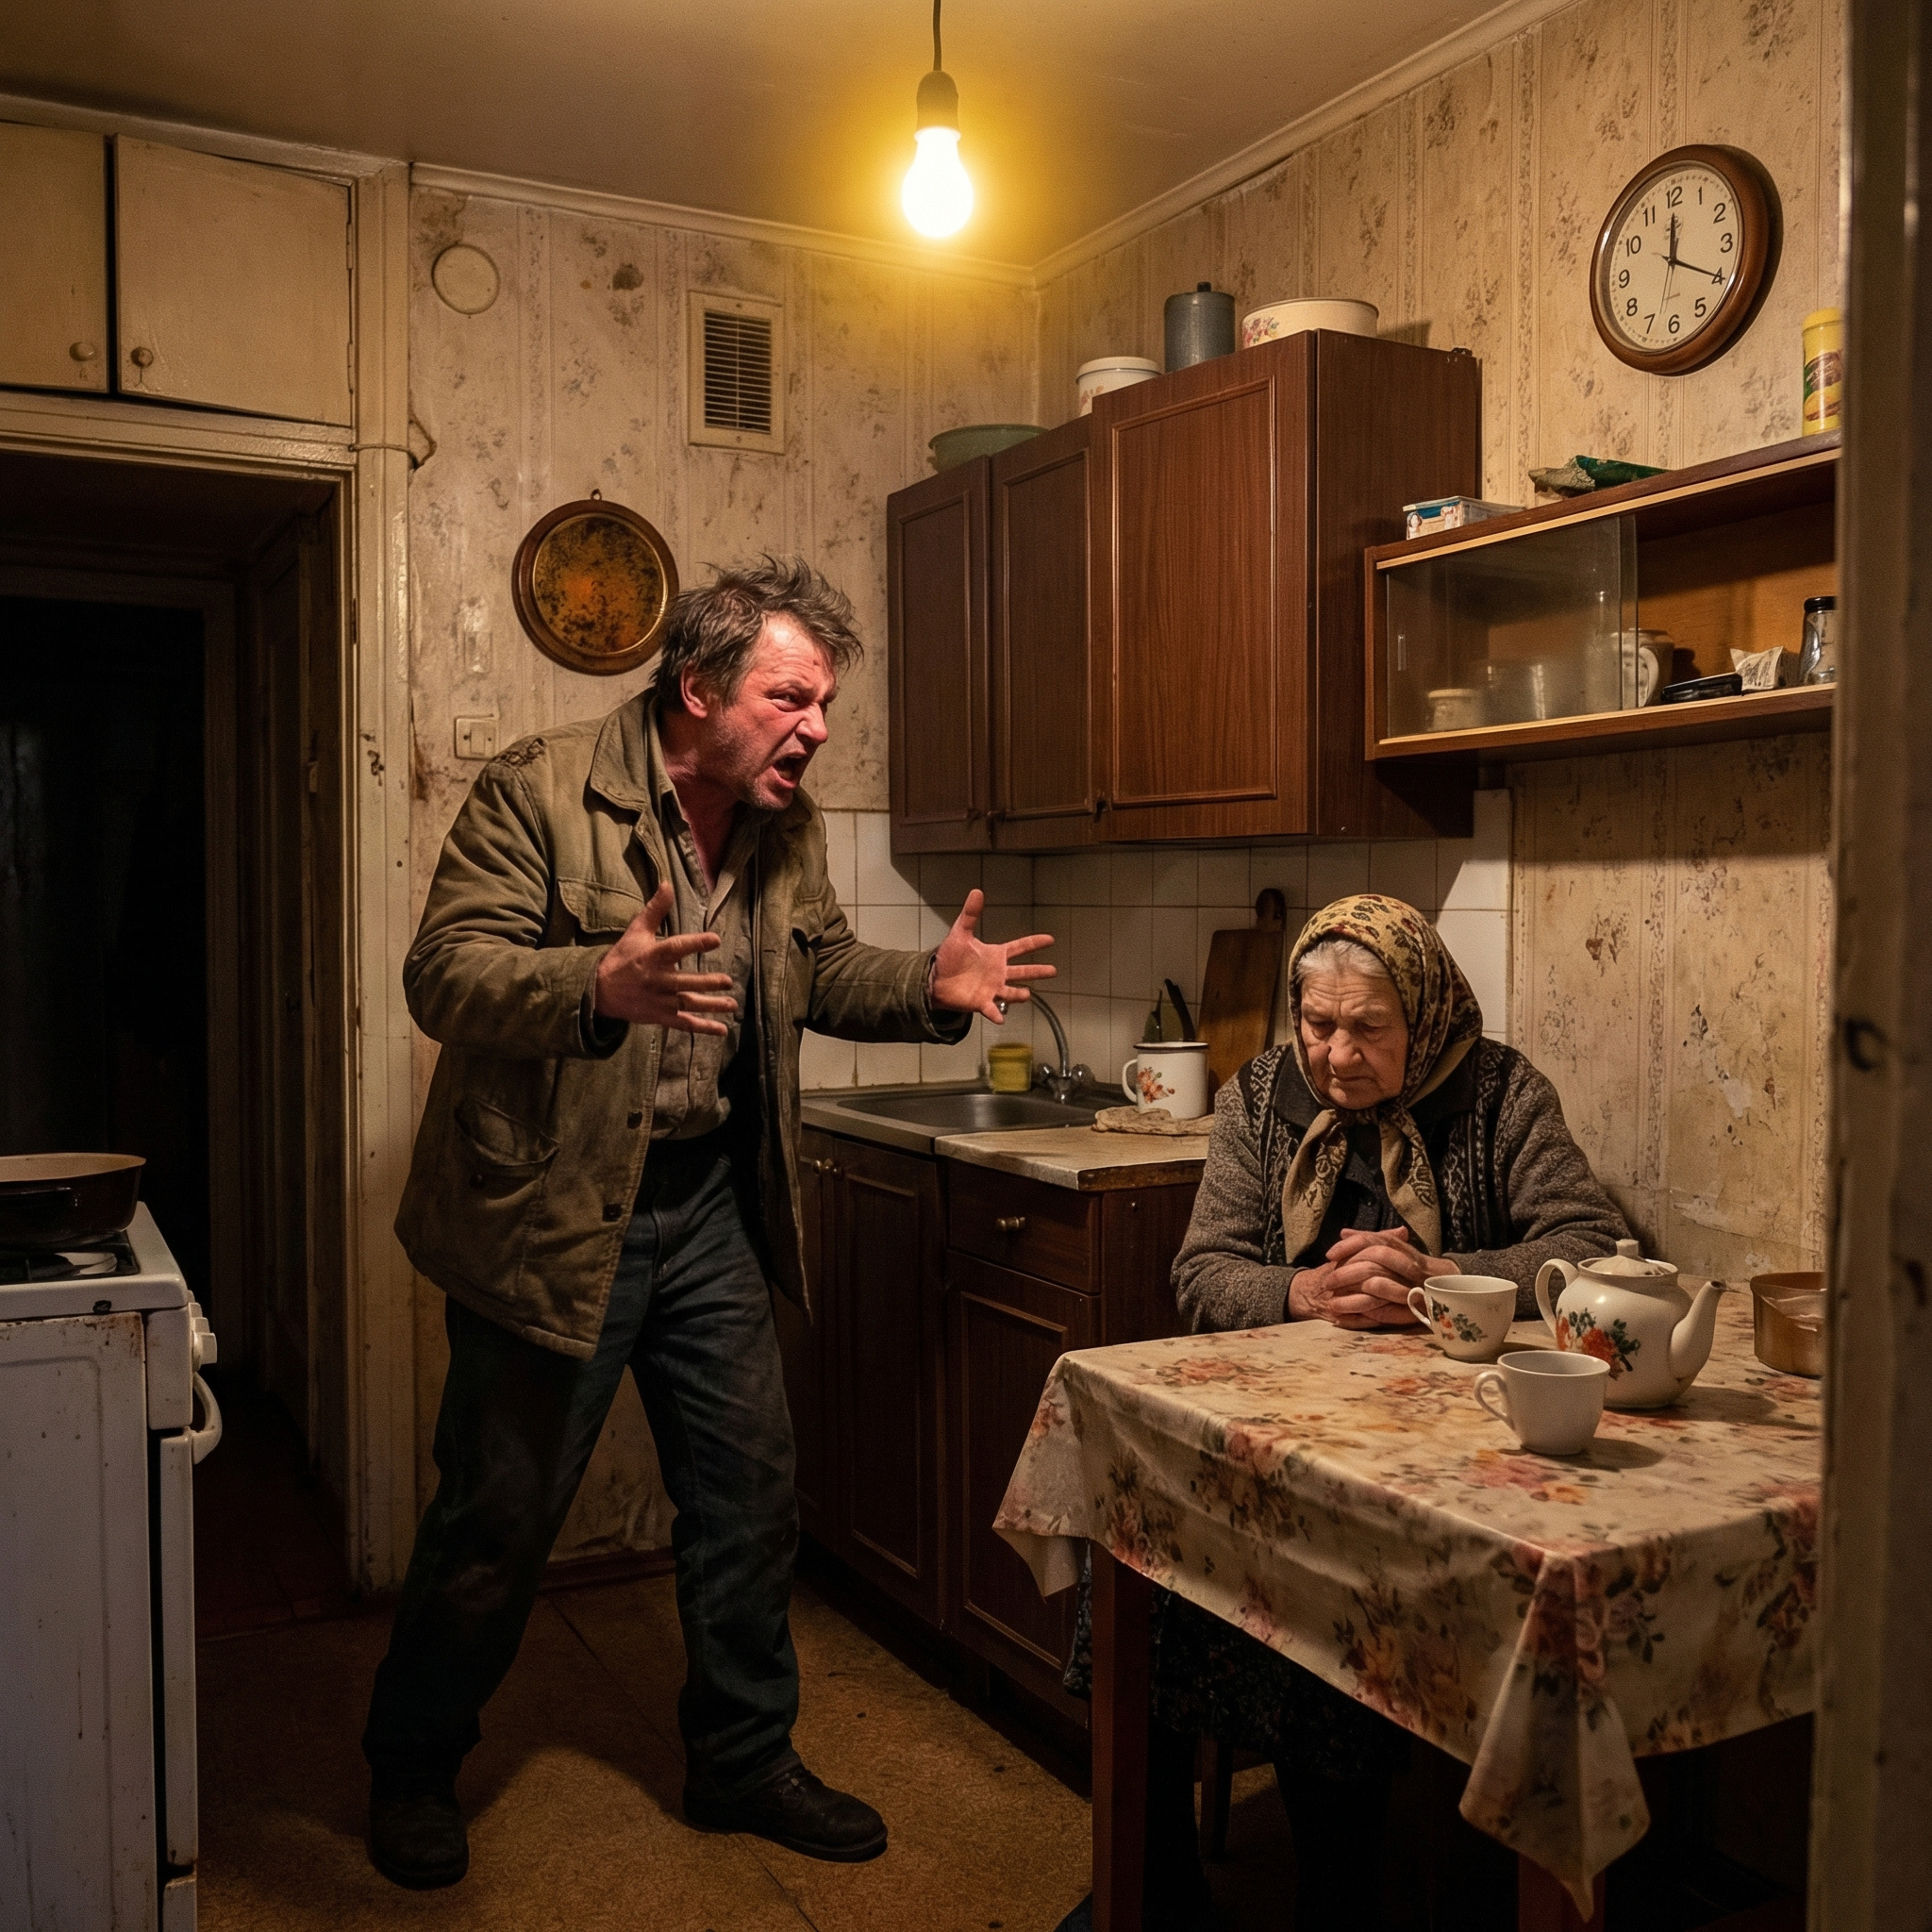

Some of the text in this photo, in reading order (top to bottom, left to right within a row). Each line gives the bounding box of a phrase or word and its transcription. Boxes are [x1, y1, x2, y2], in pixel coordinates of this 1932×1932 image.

[1666, 186, 1683, 208] 12
[1697, 186, 1703, 206] 1
[1642, 205, 1656, 226] 11
[1713, 202, 1726, 225] 2
[1625, 235, 1641, 257] 10
[1720, 232, 1733, 254] 3
[1618, 269, 1630, 289] 9
[1711, 267, 1724, 286] 4
[1626, 297, 1638, 317] 8
[1694, 297, 1707, 318] 5
[1643, 313, 1656, 334] 7
[1668, 314, 1680, 334] 6
